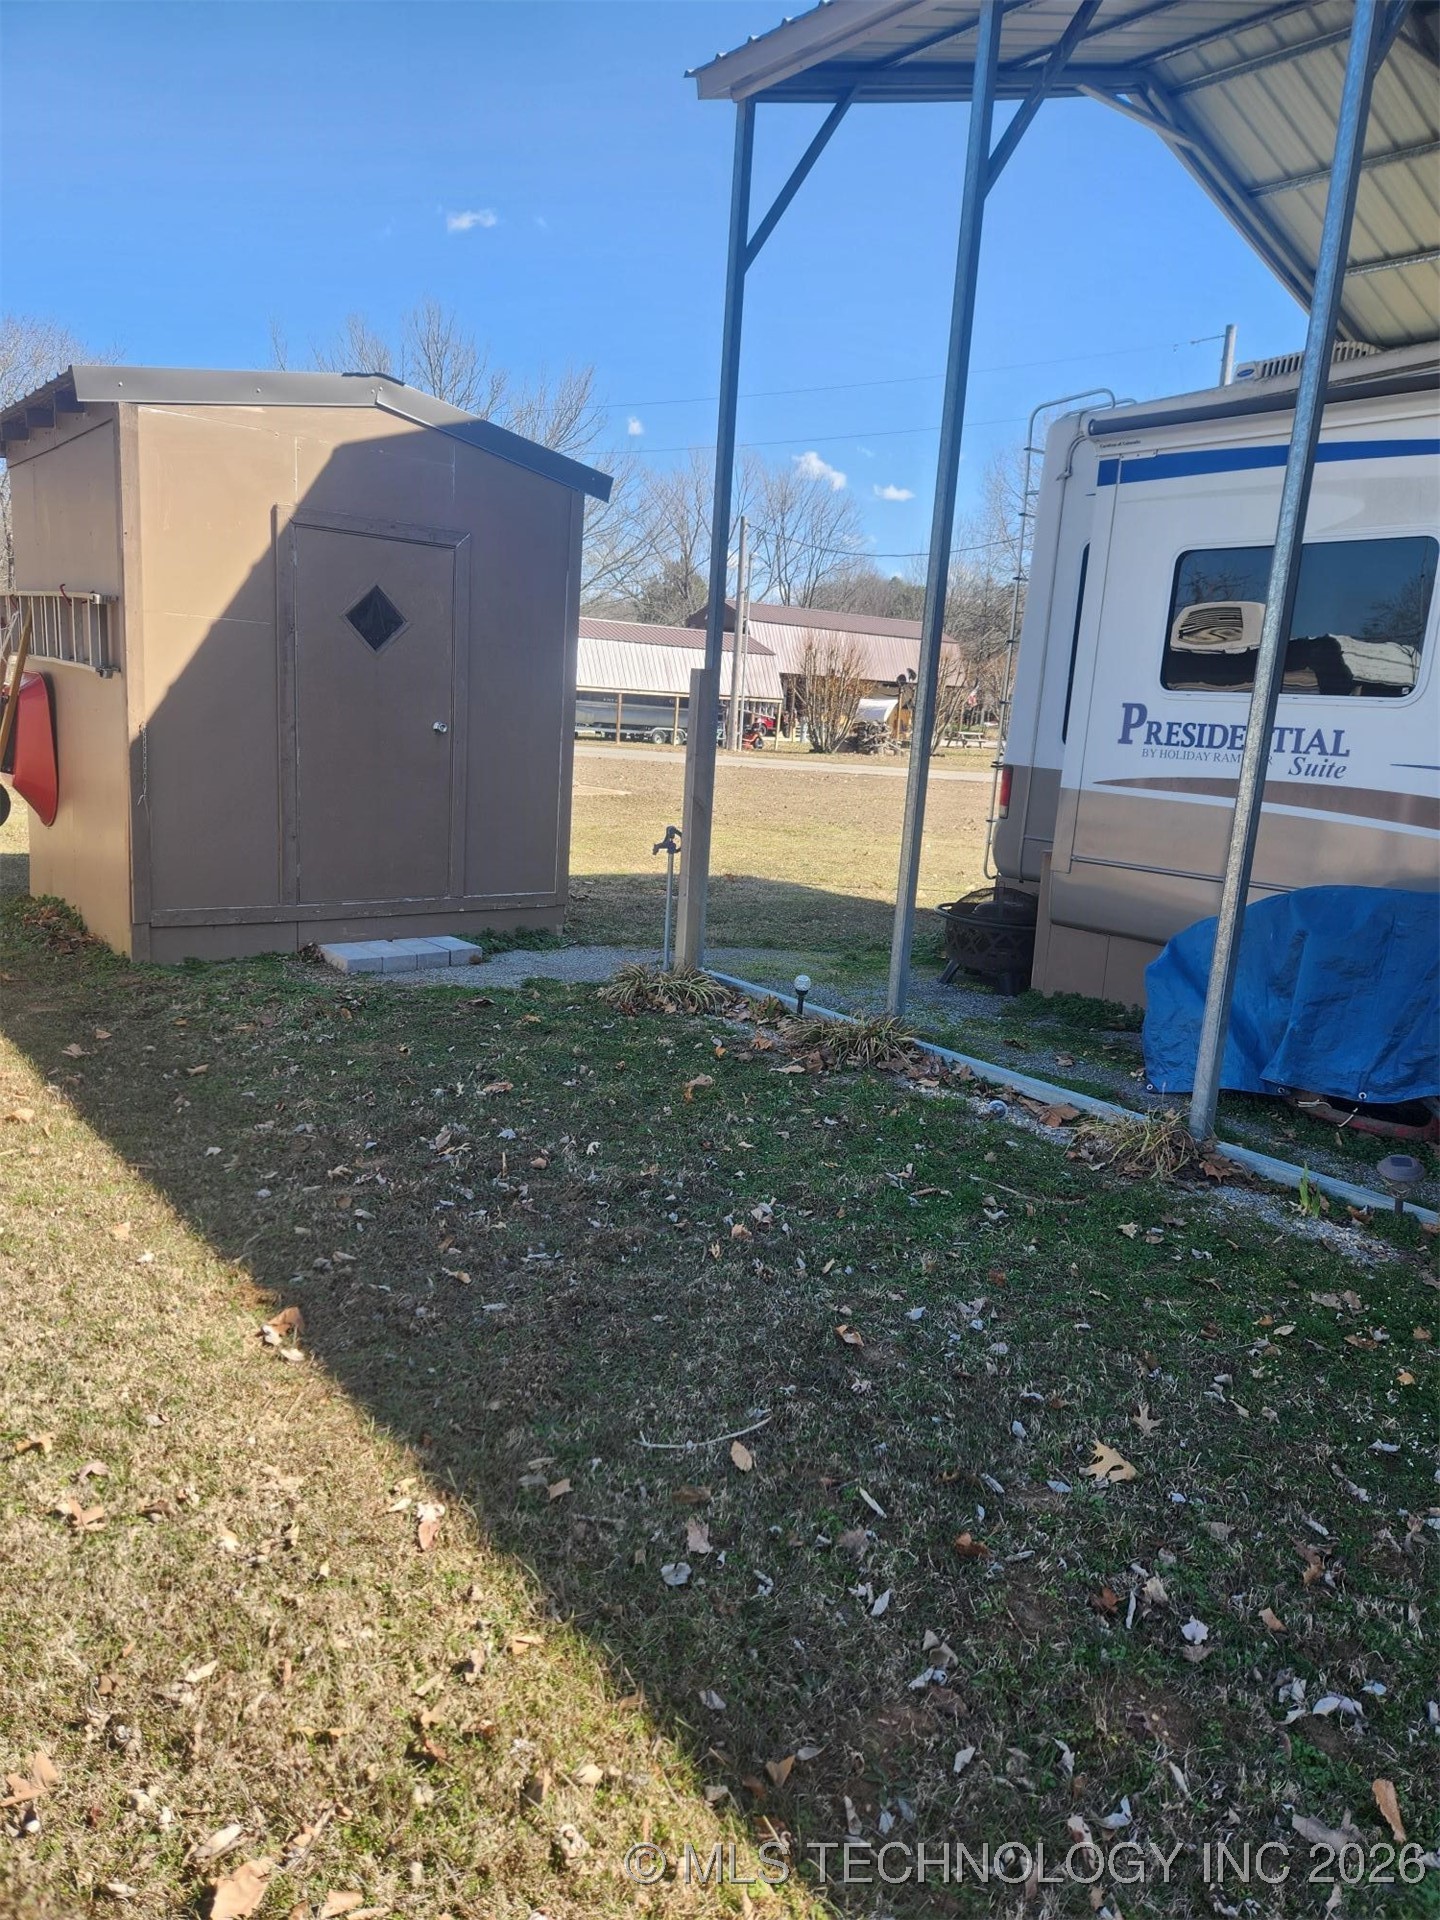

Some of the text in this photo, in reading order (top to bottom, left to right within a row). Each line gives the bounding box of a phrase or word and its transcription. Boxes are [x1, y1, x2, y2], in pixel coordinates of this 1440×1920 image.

[1117, 702, 1350, 757] PRESIDETIAL
[1141, 748, 1273, 766] BY HOLIDAY RAMR
[1288, 756, 1347, 779] Suite
